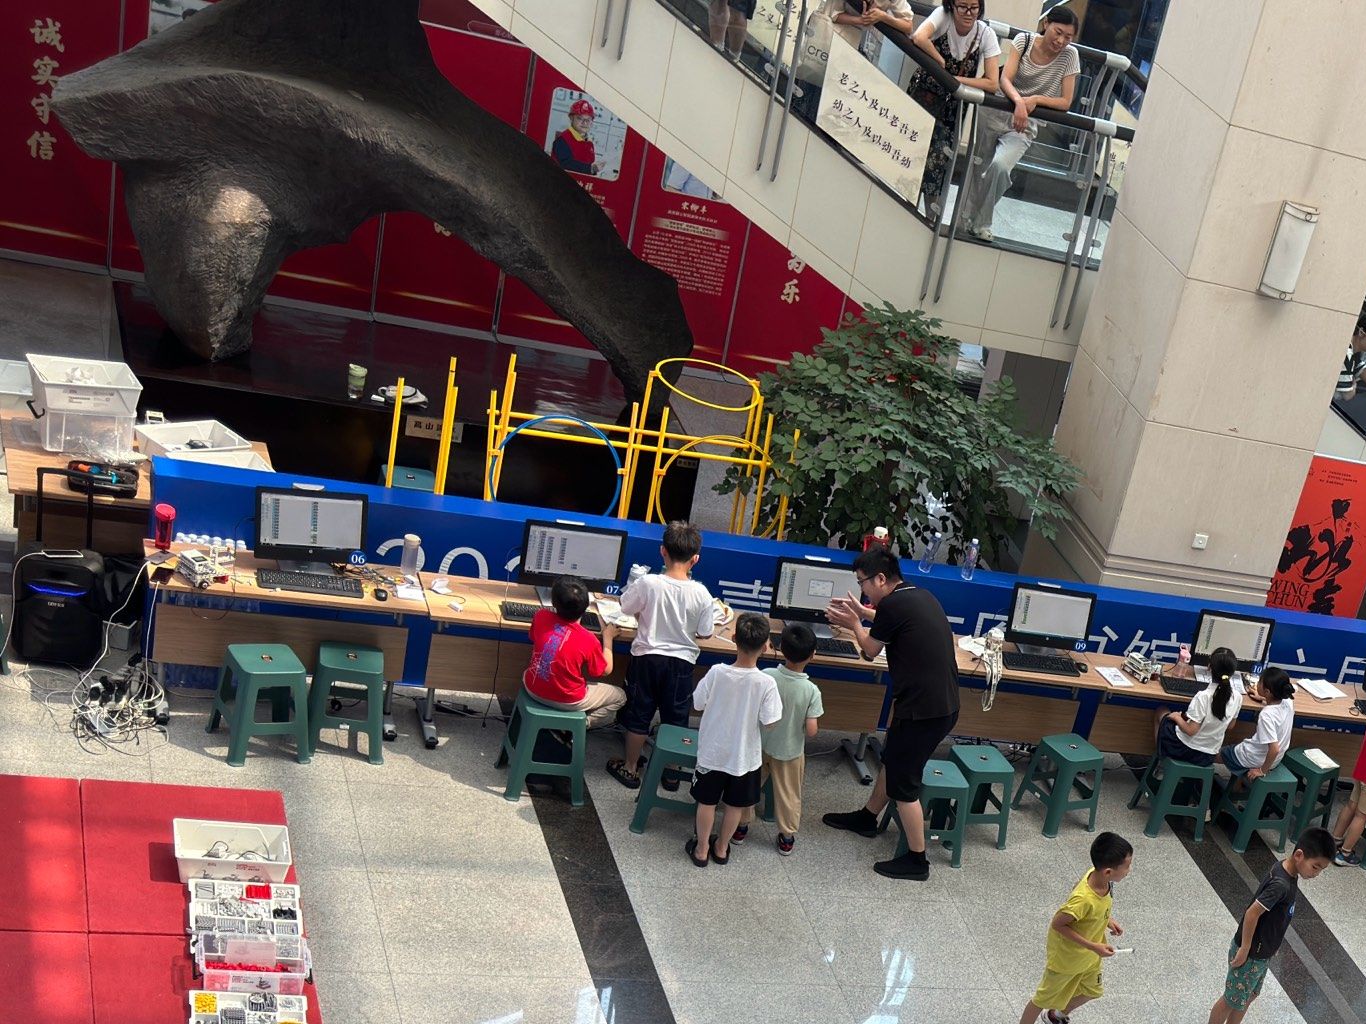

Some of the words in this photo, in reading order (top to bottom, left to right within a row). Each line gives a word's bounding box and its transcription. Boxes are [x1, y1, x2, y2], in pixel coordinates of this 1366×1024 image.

[351, 553, 365, 564] 06
[606, 585, 620, 594] 07
[1075, 642, 1087, 651] 09
